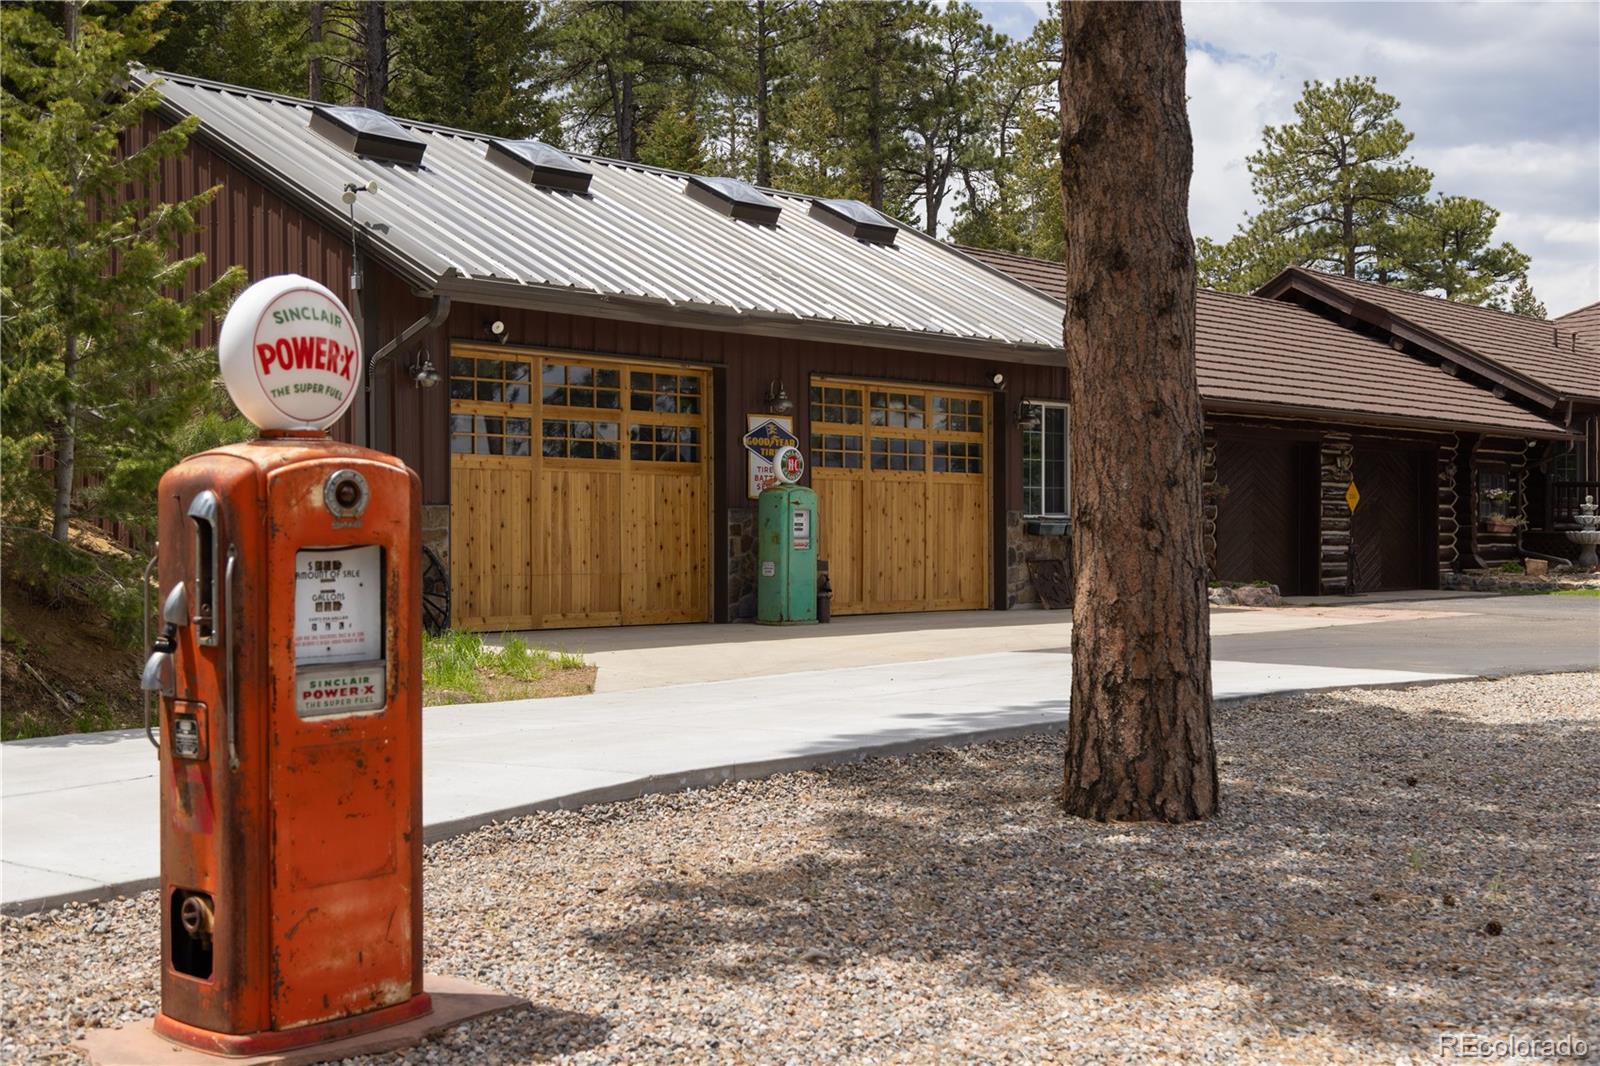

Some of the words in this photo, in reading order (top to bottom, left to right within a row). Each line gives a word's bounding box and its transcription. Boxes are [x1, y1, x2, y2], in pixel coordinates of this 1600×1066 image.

[272, 306, 343, 328] SINCLAIR
[256, 336, 354, 381] POWER-X
[270, 383, 291, 398] THE
[293, 382, 324, 395] SUPER
[324, 385, 343, 401] FUEL
[295, 571, 328, 580] AMOUNT
[330, 570, 340, 579] OF
[343, 569, 360, 578] SALE
[312, 593, 345, 602] GALLONS
[309, 676, 370, 689] SINCLAIR
[305, 700, 320, 709] THE
[323, 698, 351, 707] SUPER
[354, 696, 374, 704] FUEL
